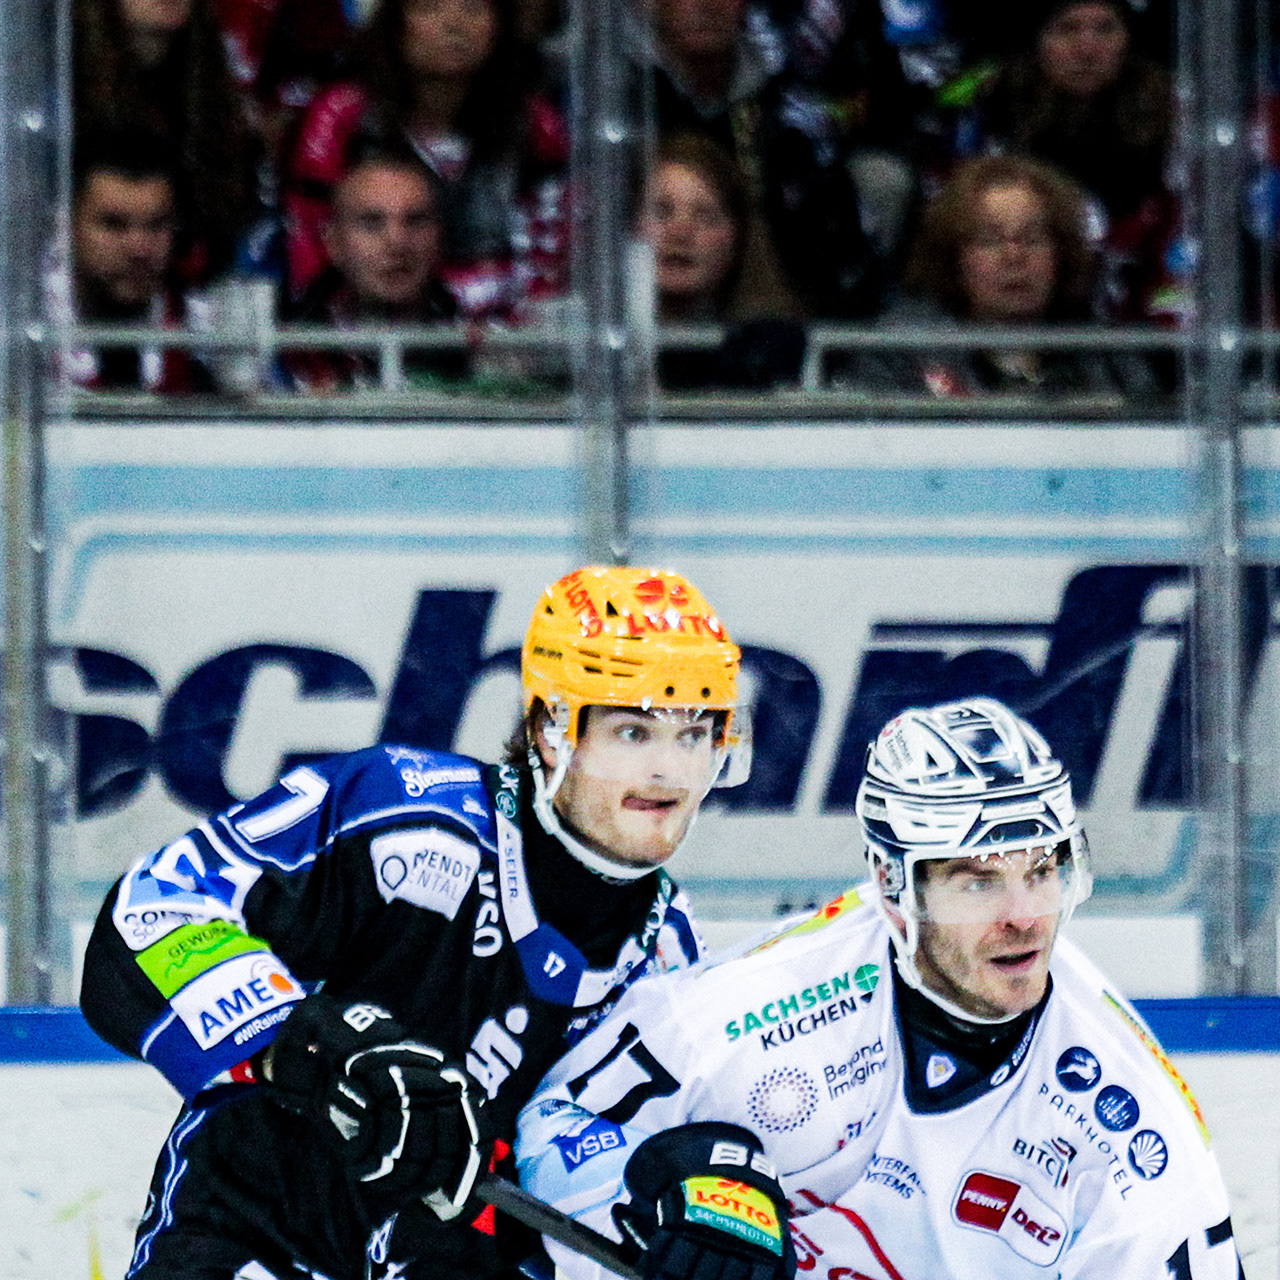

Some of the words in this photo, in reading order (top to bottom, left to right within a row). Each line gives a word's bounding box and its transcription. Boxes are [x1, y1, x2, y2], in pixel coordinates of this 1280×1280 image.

[724, 972, 851, 1043] SACHSEN
[760, 995, 858, 1052] KÜCHEN
[565, 1130, 621, 1166] VSB
[1037, 1081, 1136, 1202] PARKHOTEL
[695, 1189, 777, 1228] LOTTO
